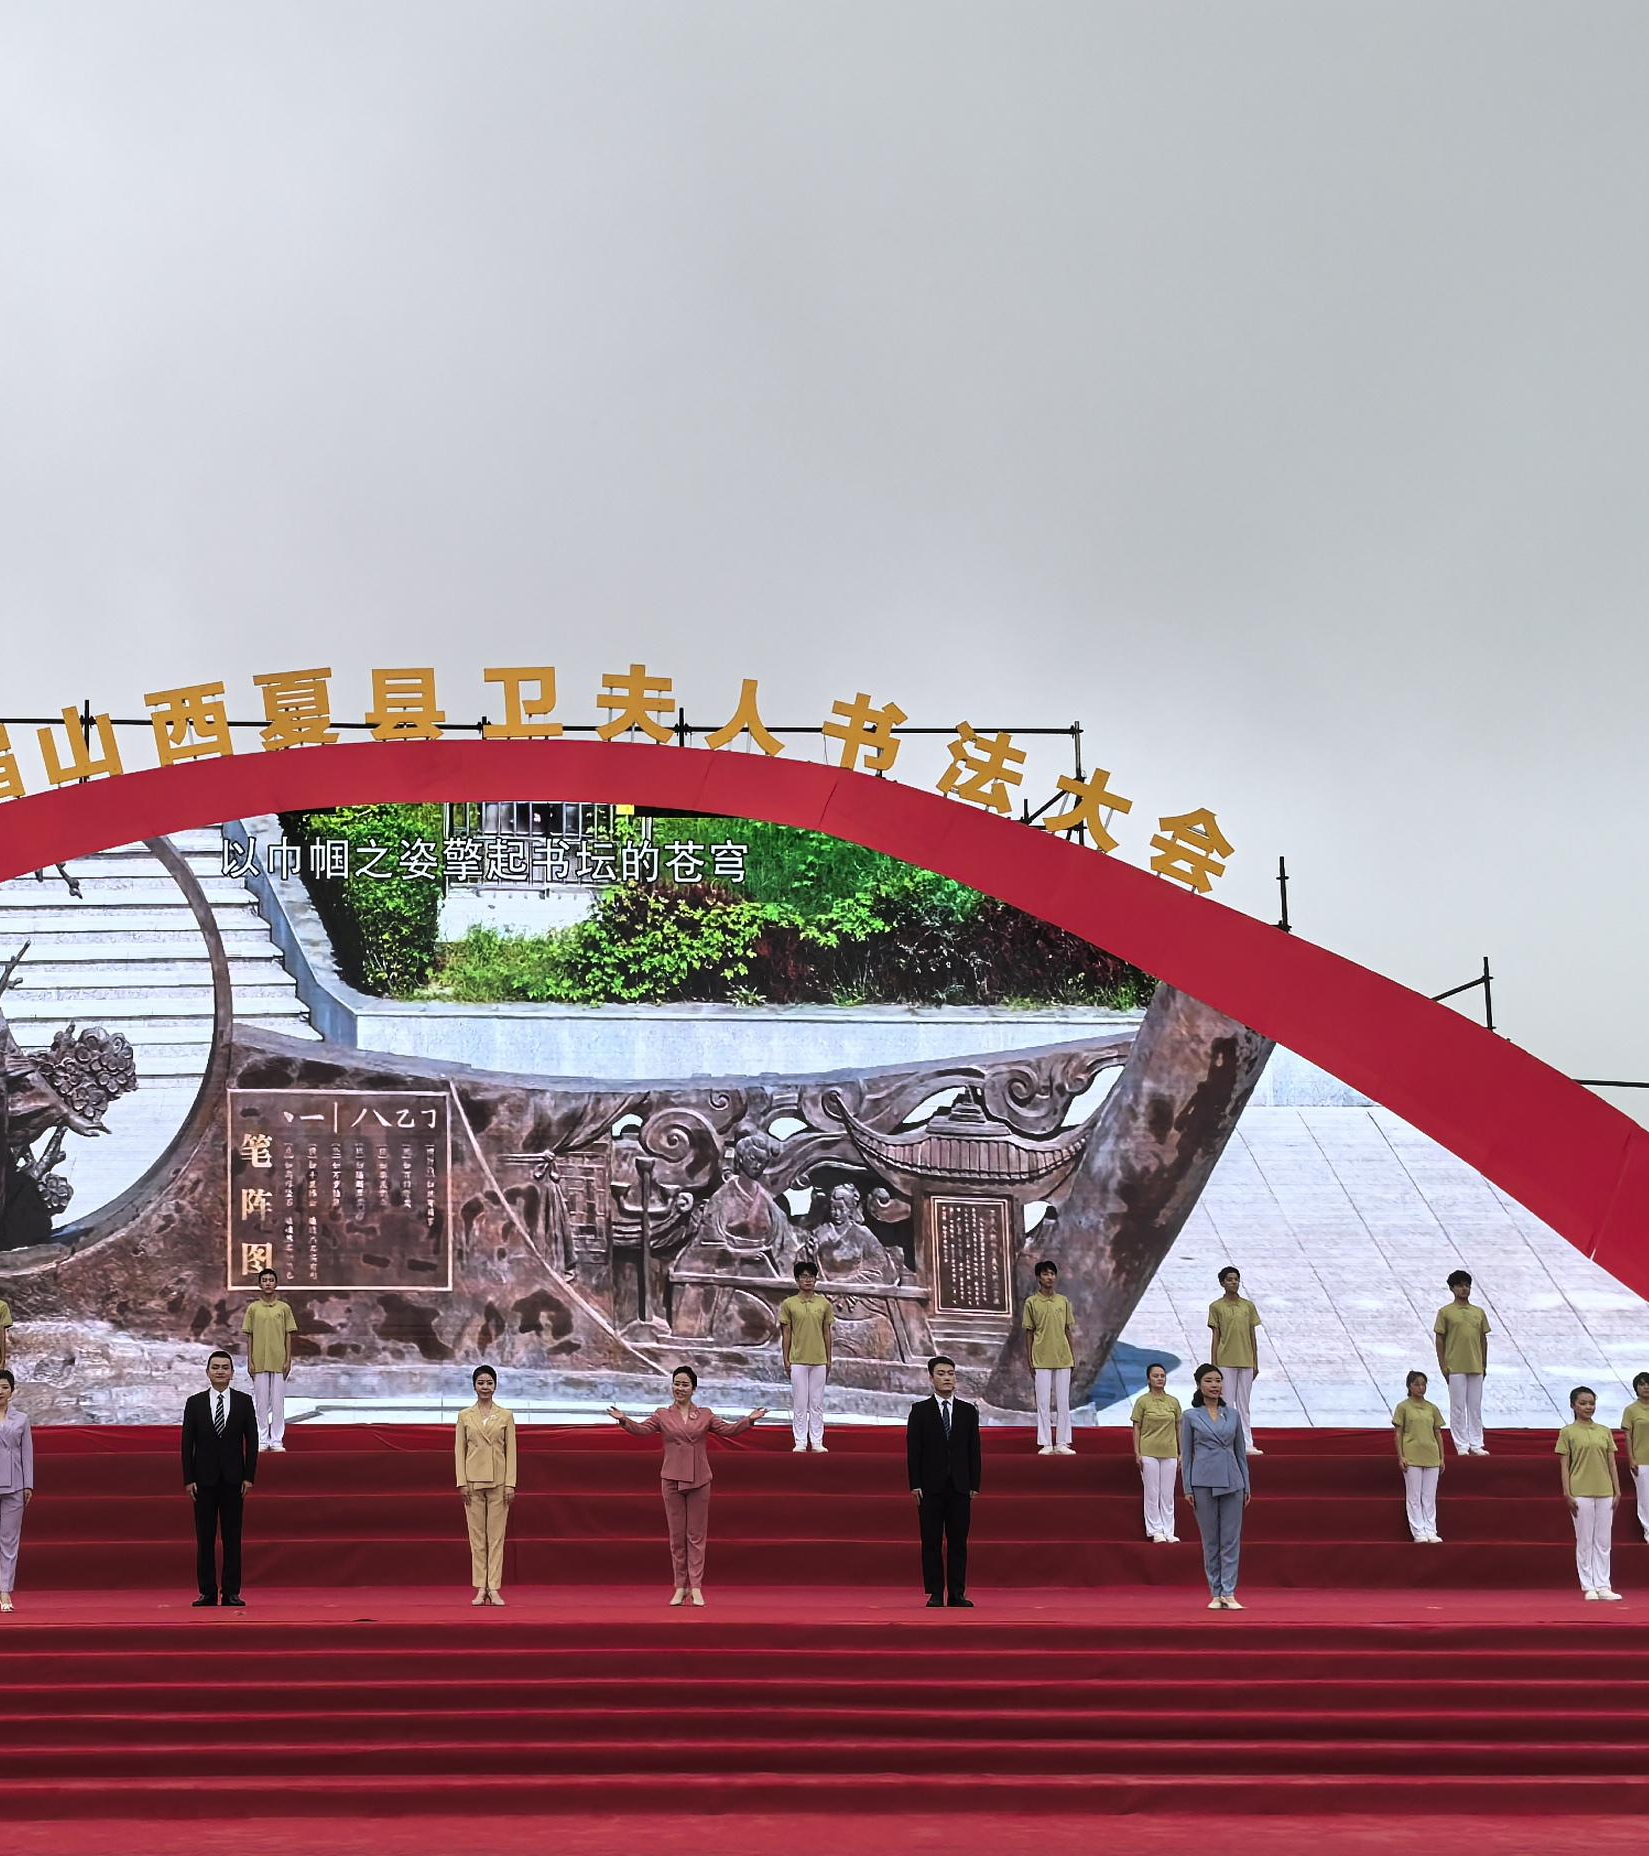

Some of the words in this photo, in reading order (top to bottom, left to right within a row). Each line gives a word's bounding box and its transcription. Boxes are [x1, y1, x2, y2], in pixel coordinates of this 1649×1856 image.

[221, 837, 749, 884] 以巾帼之姿擎起书坛的苍穹
[240, 1133, 273, 1276] 笔阵图
